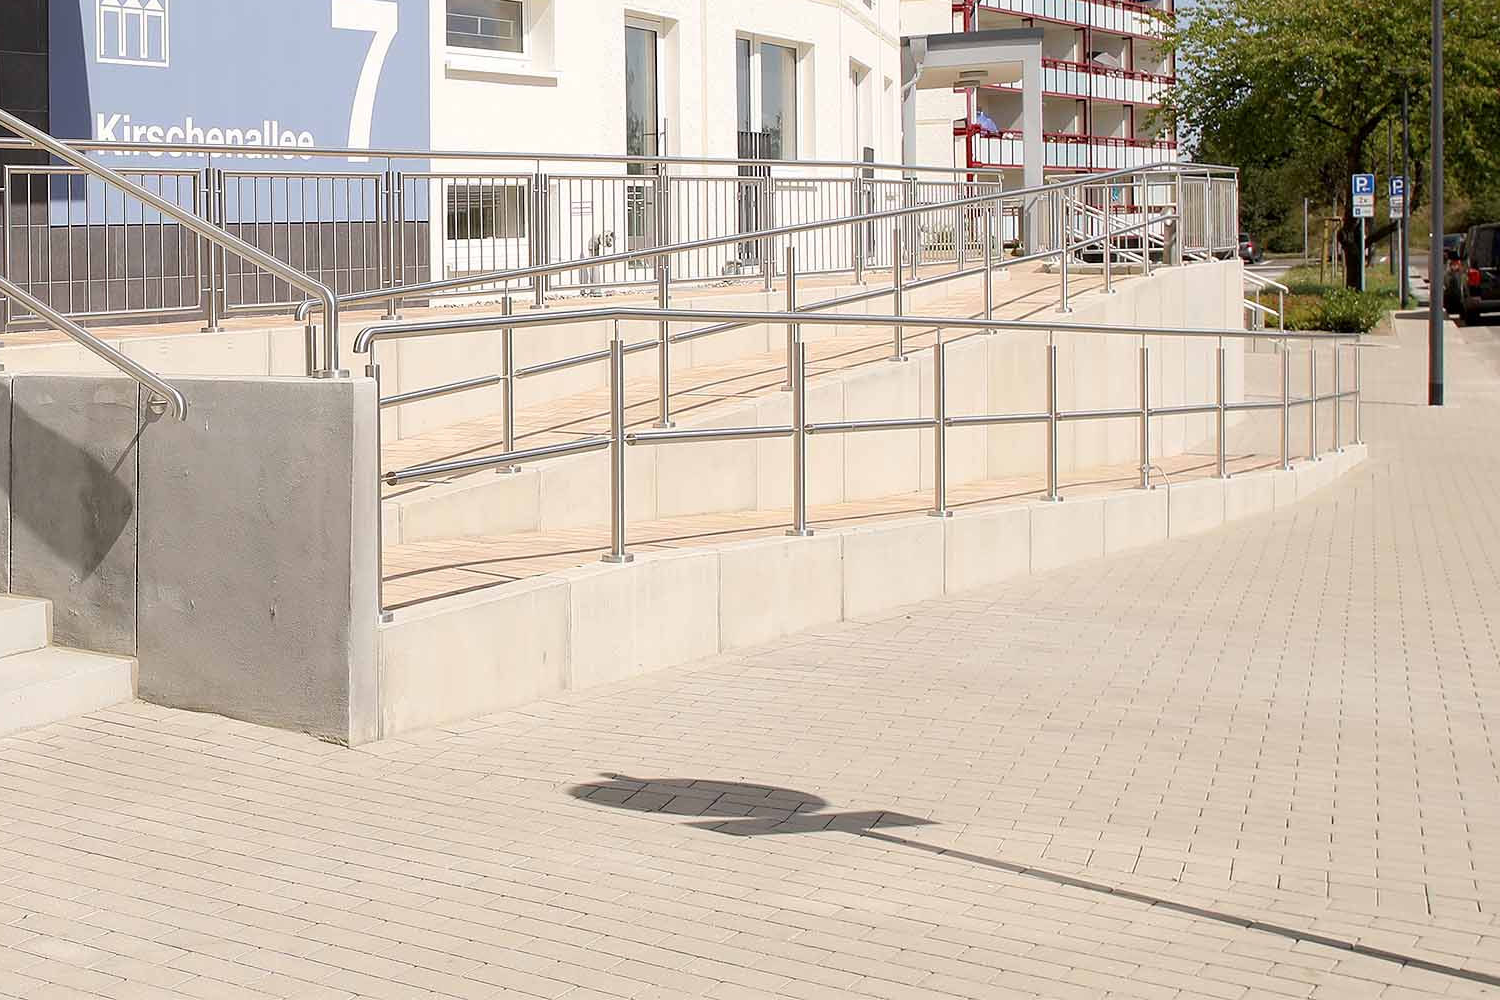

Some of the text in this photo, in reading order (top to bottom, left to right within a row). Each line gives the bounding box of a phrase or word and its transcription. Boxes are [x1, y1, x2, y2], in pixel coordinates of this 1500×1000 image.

[97, 113, 315, 160] Kirschenallee
[1356, 177, 1368, 193] P
[1393, 180, 1403, 195] P
